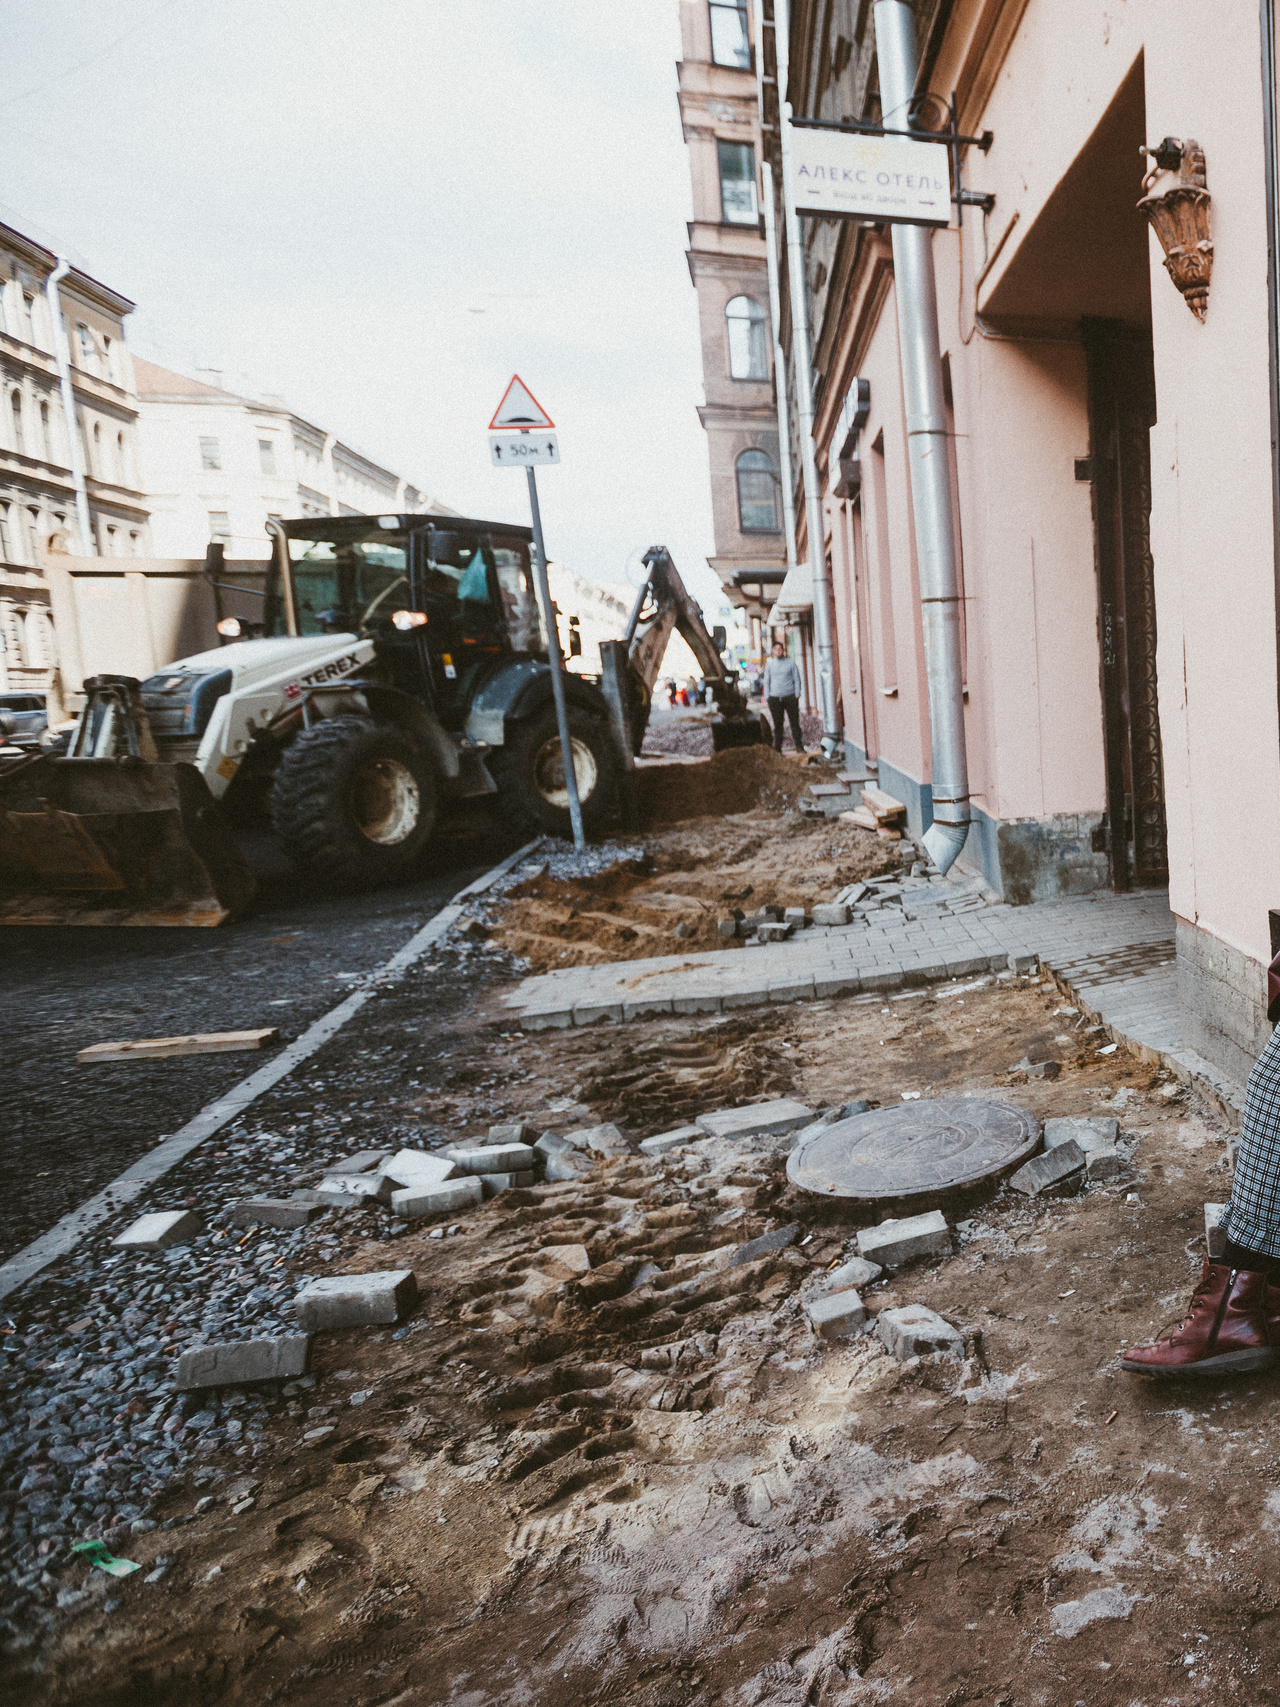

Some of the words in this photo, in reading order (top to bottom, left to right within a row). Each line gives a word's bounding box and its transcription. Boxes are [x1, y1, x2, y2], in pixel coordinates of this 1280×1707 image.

[798, 163, 867, 184] АЛЕКС
[876, 171, 943, 190] ОТЕЛЬ
[301, 651, 360, 685] TEREX
